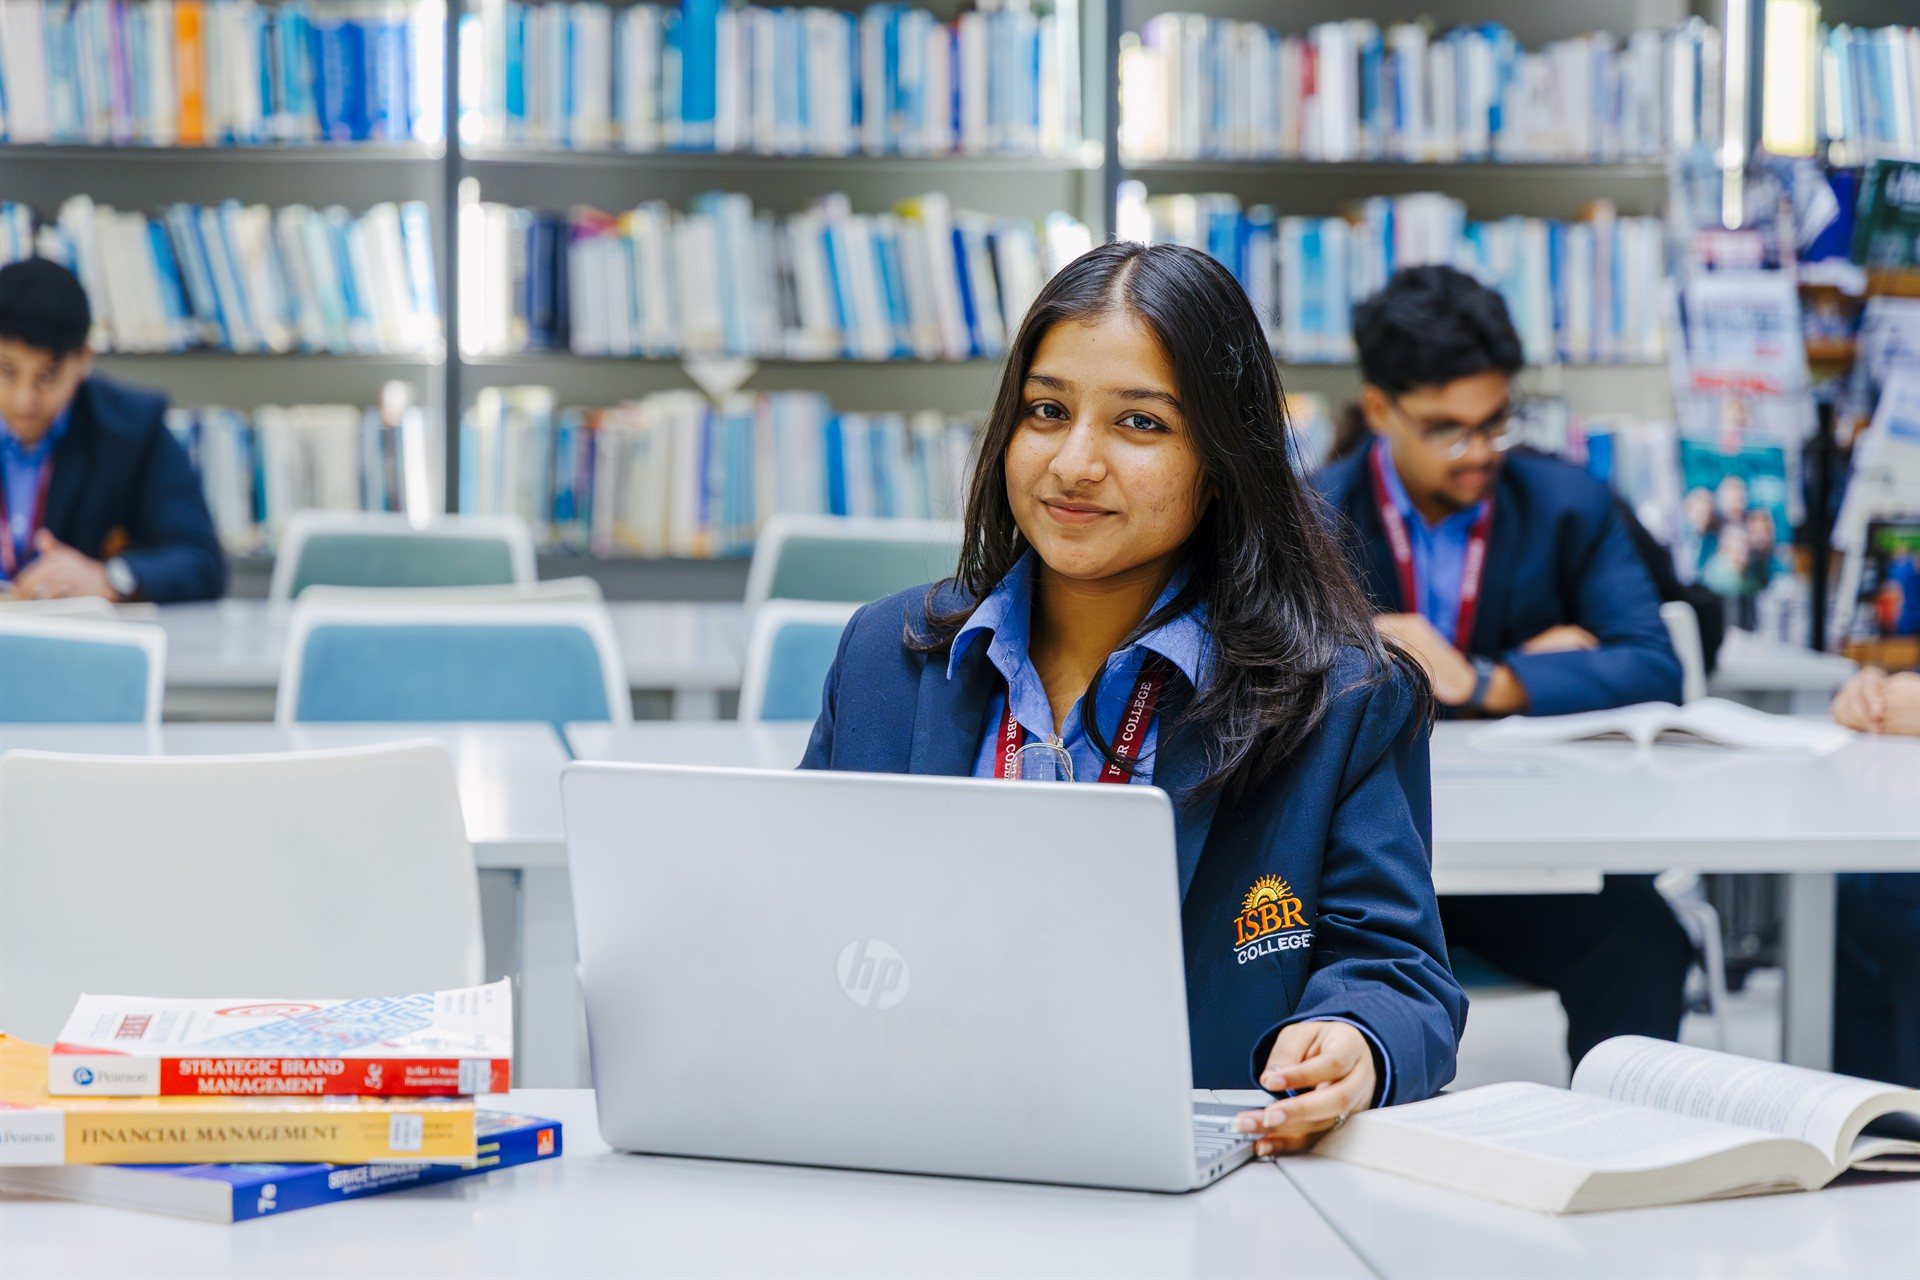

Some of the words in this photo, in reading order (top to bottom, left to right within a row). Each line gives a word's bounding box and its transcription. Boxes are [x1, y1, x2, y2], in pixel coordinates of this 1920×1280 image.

[1109, 745, 1130, 776] ISR
[1122, 682, 1152, 742] COLLEGE
[1233, 897, 1310, 947] ISBR
[1237, 933, 1314, 965] COLLEGE
[843, 937, 905, 1009] hp
[178, 1059, 279, 1076] STRATEGIC
[281, 1059, 346, 1076] BRAND
[197, 1076, 327, 1094] MANAGEMENT
[81, 1127, 188, 1145] FINANCIAL
[196, 1124, 341, 1143] MANAGEMENT
